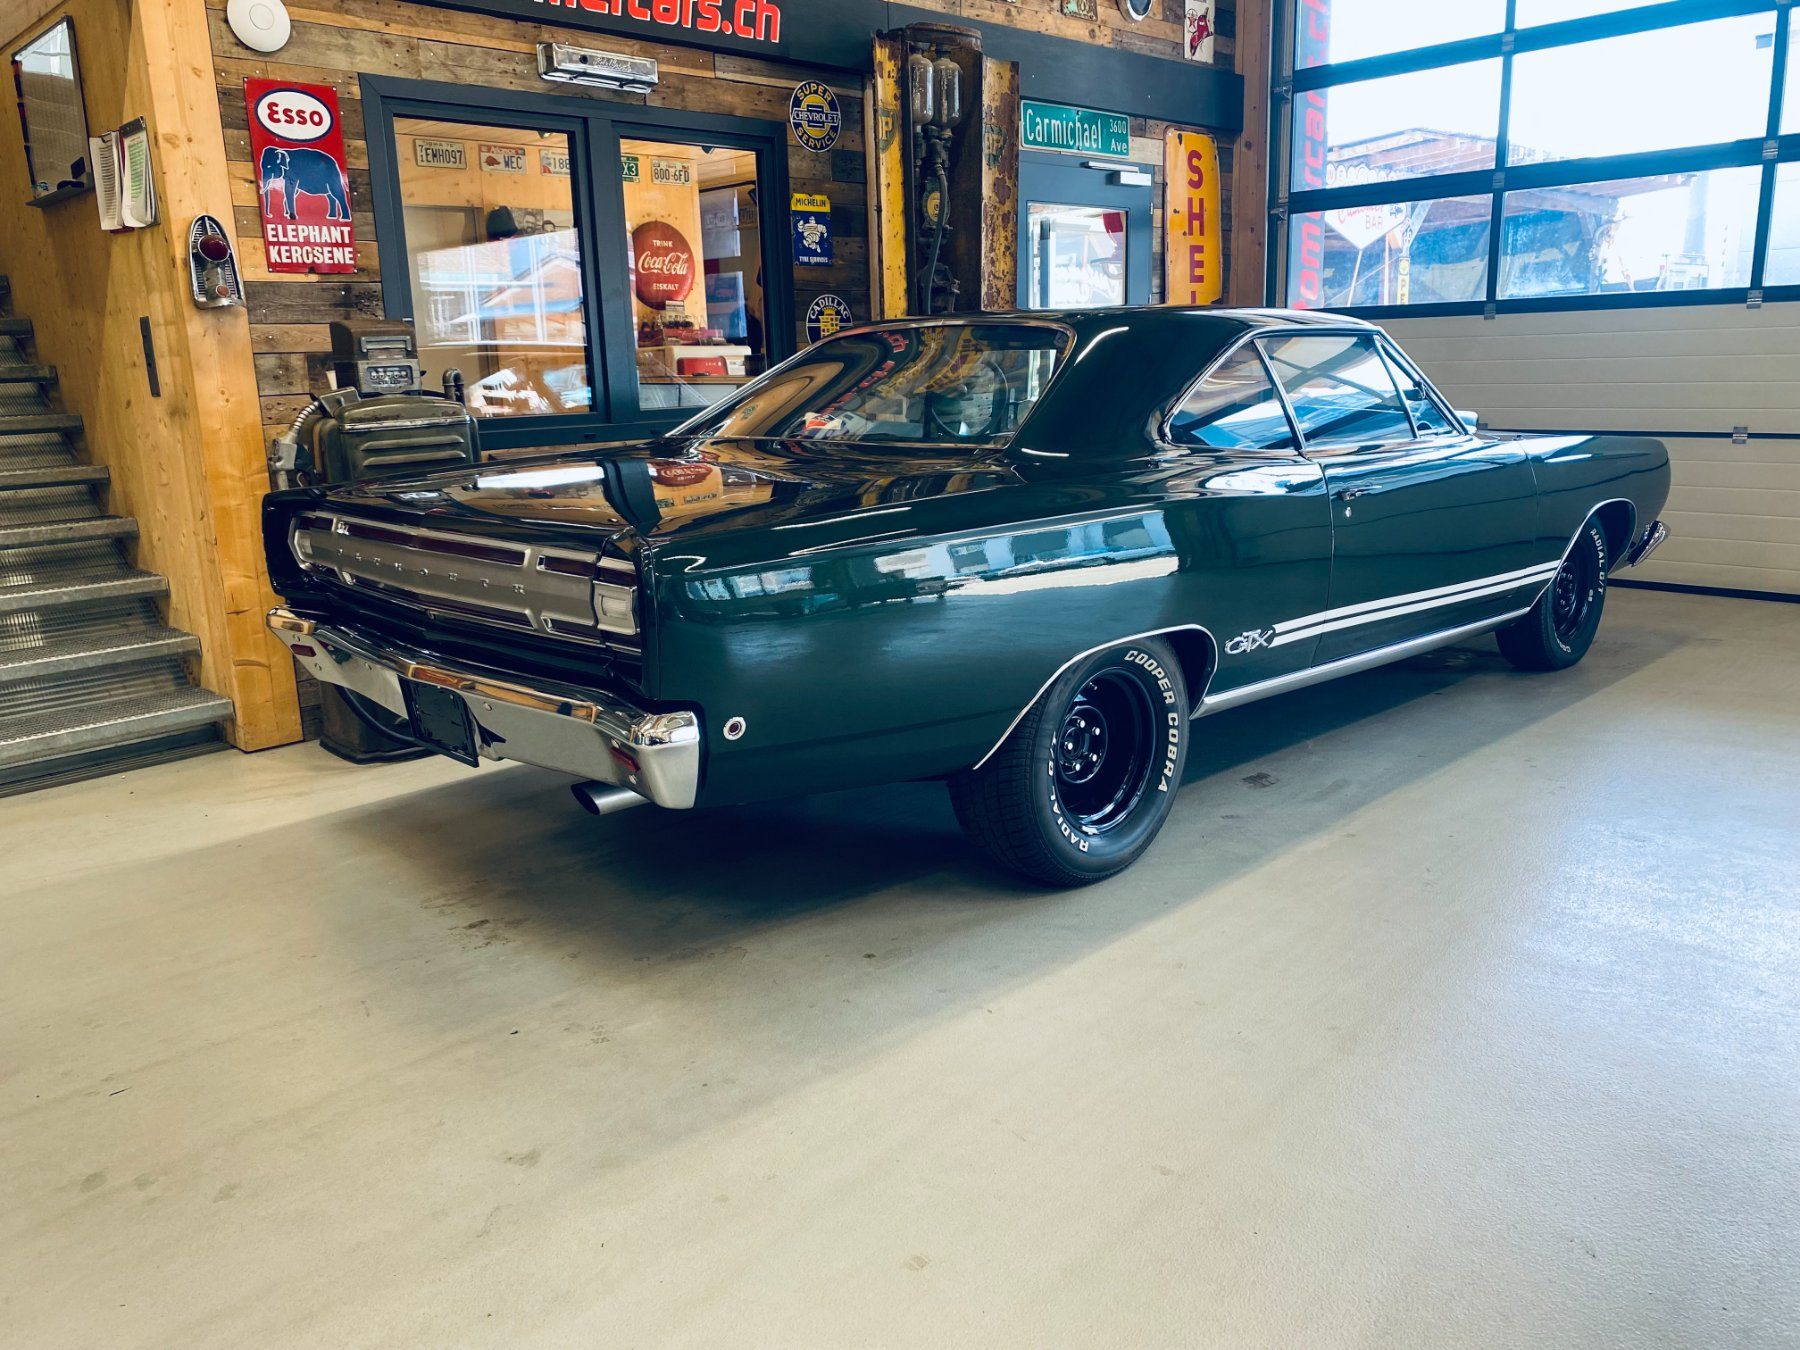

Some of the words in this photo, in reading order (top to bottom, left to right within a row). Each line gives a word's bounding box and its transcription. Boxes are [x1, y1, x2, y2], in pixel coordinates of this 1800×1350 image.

[534, 0, 781, 43] cars.ch
[797, 83, 832, 102] SUPER
[266, 101, 324, 127] Esso
[794, 111, 839, 123] CHEVROLET
[796, 127, 836, 149] SERVICE
[1026, 108, 1102, 150] Carmichael
[1110, 119, 1127, 134] 3600
[1110, 138, 1127, 153] Ave
[795, 198, 827, 208] MICHELIN
[266, 224, 351, 244] ELEPHANT
[652, 239, 673, 248] TRINK
[269, 245, 355, 265] KEROSENE
[638, 250, 689, 276] Coca-Cola
[652, 282, 679, 291] EISKALT
[810, 296, 850, 319] CADILLAC
[1590, 528, 1603, 567] RADIAL
[1123, 650, 1176, 704] COOPER
[1158, 712, 1178, 793] COBRA
[1051, 786, 1090, 853] RADIAL
